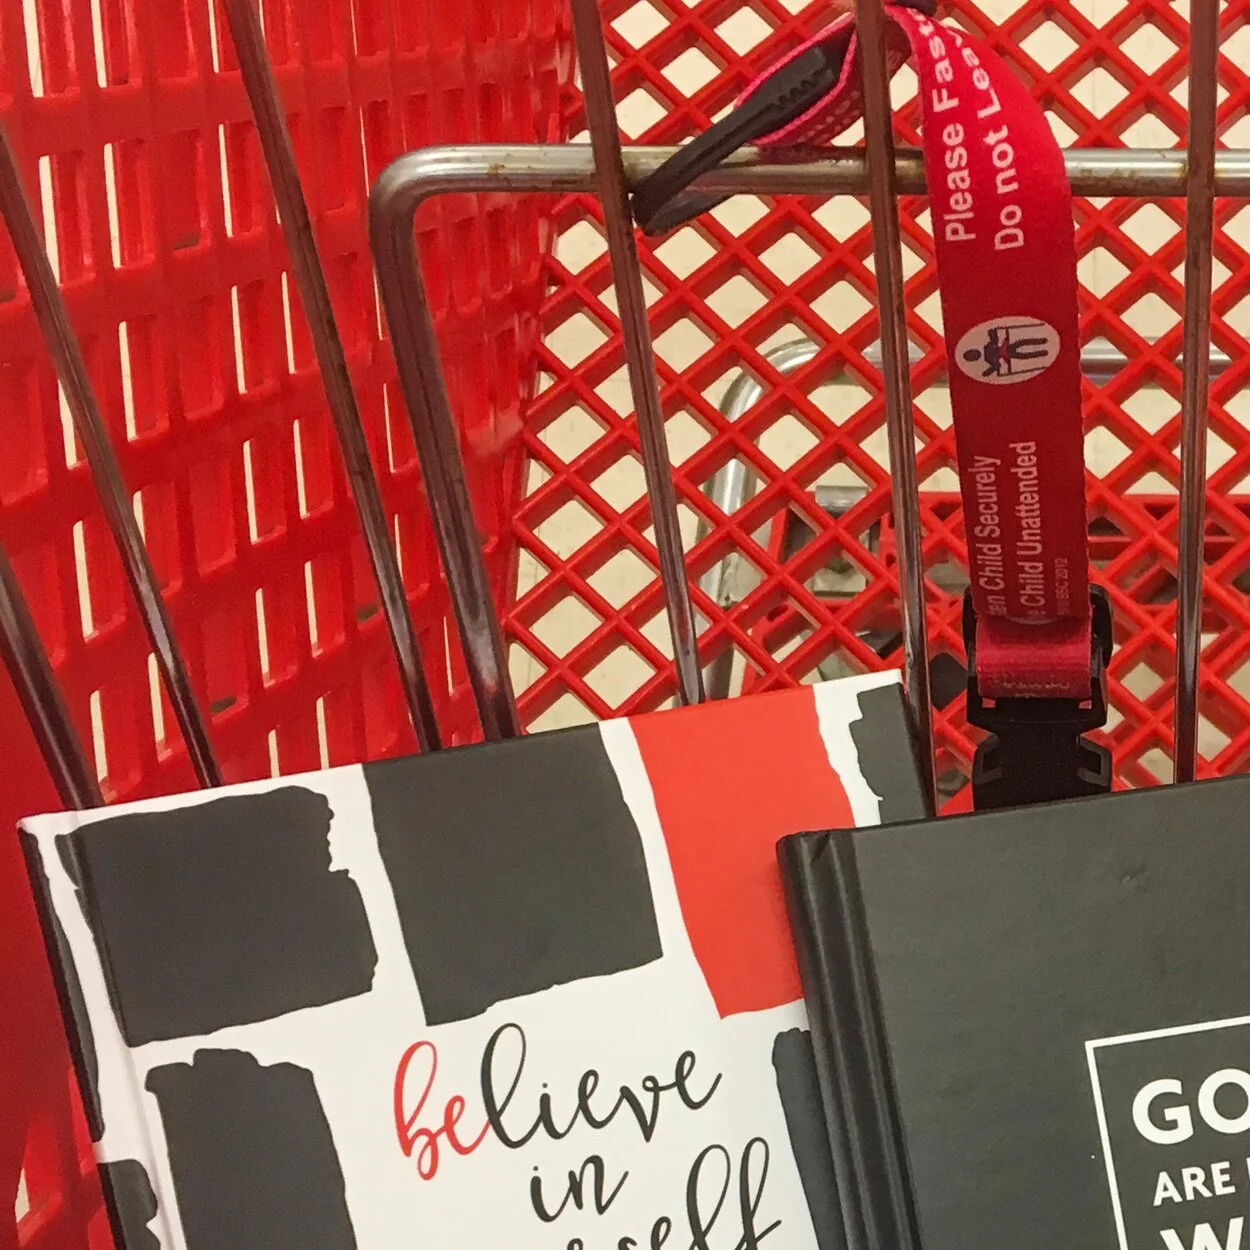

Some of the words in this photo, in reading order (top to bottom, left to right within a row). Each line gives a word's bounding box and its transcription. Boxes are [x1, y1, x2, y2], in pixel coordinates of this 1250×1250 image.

[943, 122, 976, 241] Please
[983, 125, 1018, 194] not
[994, 204, 1024, 250] Do
[968, 455, 1001, 538] Securely
[1009, 441, 1041, 555] Unattended
[975, 544, 1005, 590] Child
[1018, 561, 1046, 606] Child
[393, 1023, 723, 1180] believe
[530, 1155, 629, 1222] in
[1153, 1160, 1236, 1206] ARE
